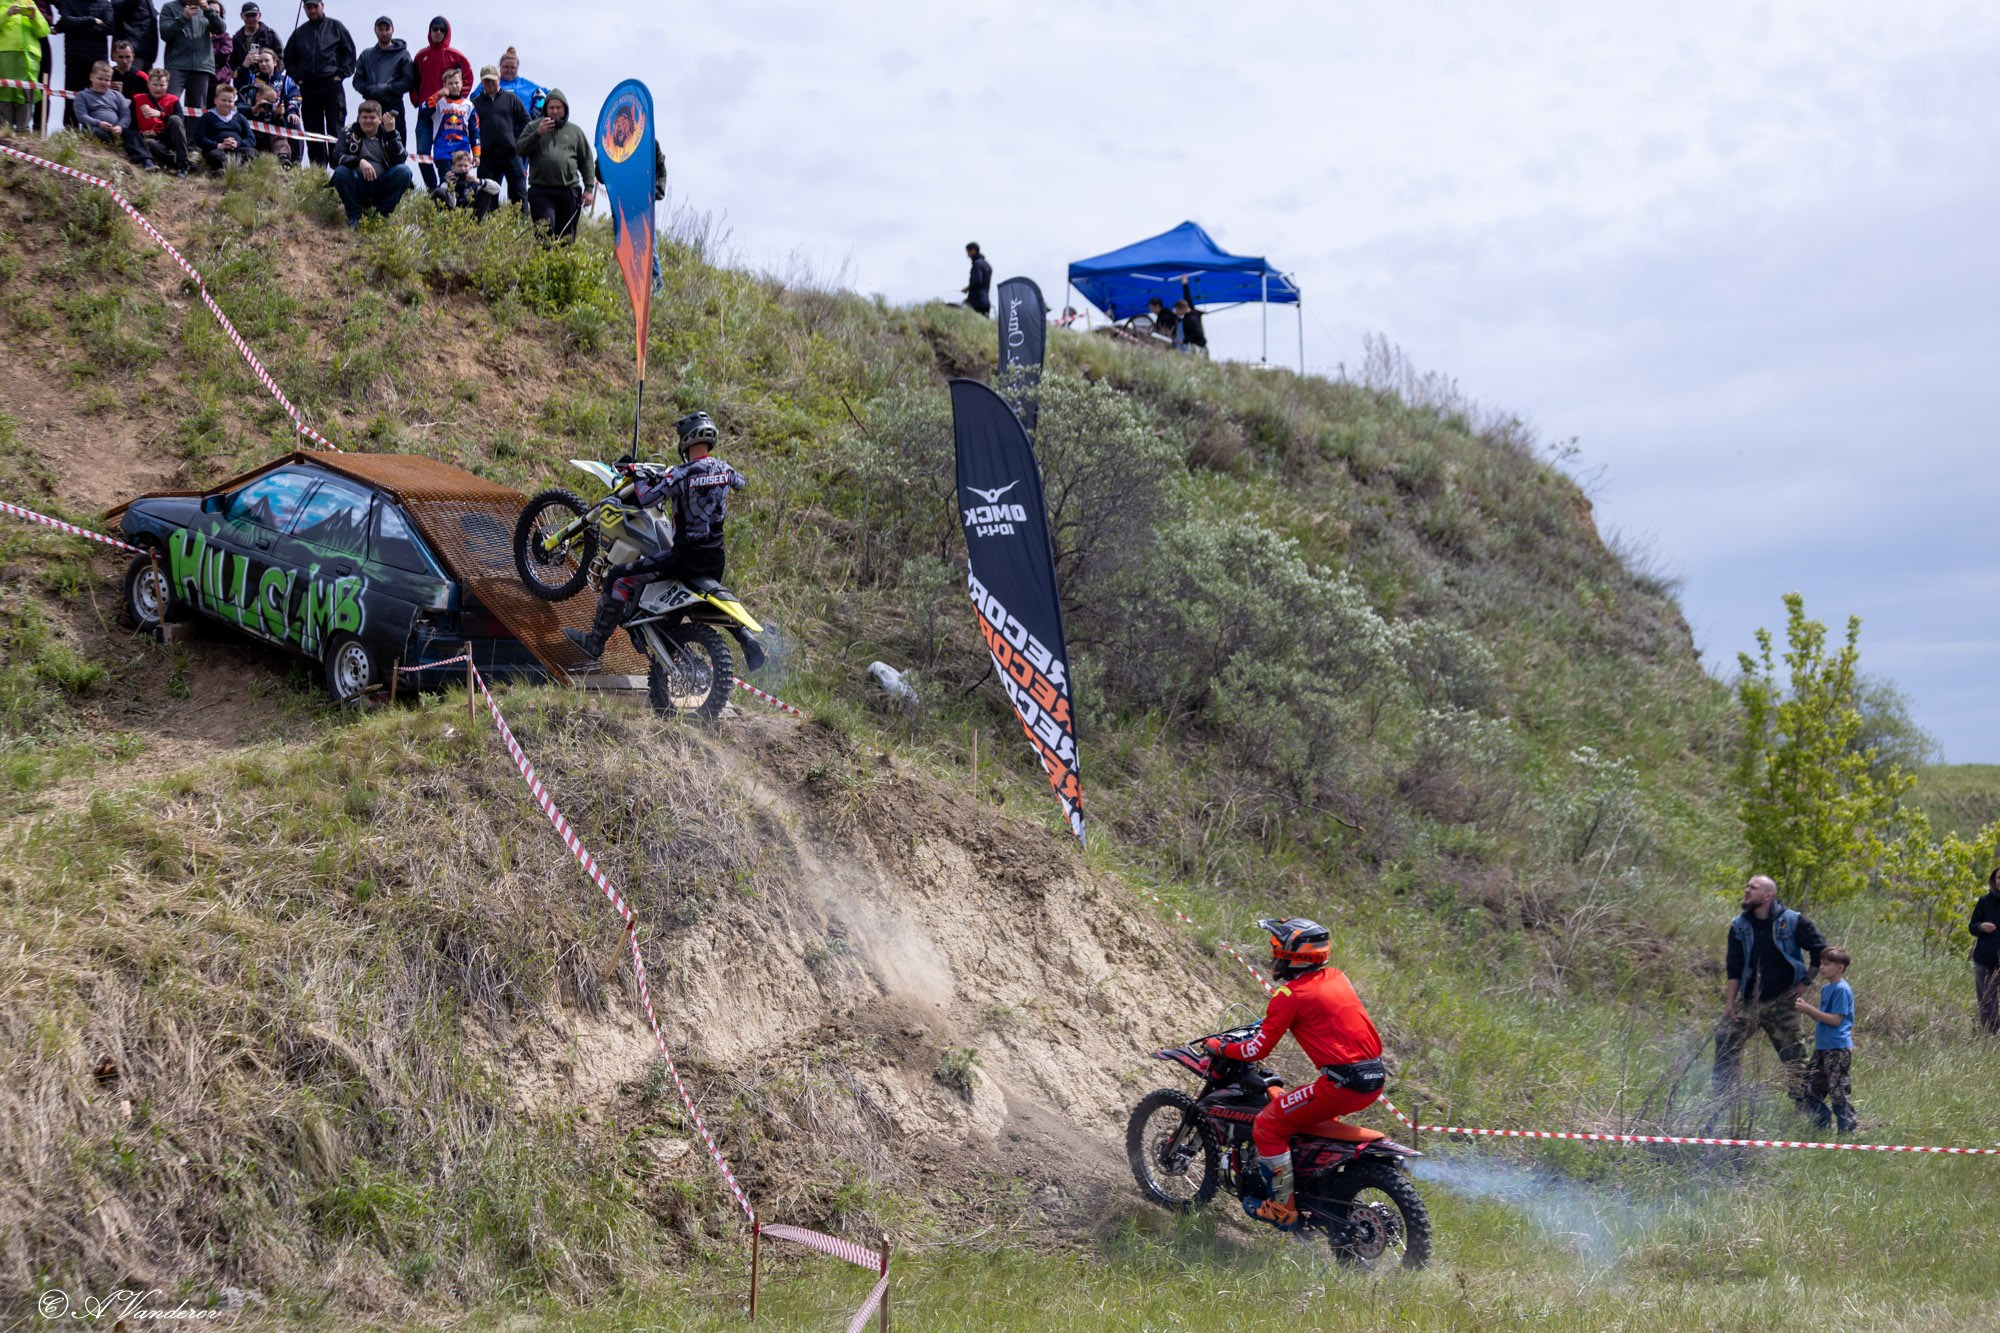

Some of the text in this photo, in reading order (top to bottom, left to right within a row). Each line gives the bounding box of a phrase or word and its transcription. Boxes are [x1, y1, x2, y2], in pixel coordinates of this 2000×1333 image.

[1240, 1029, 1267, 1059] LEATT
[1280, 1084, 1315, 1109] LEATT
[1207, 1107, 1255, 1123] ZUUMA
